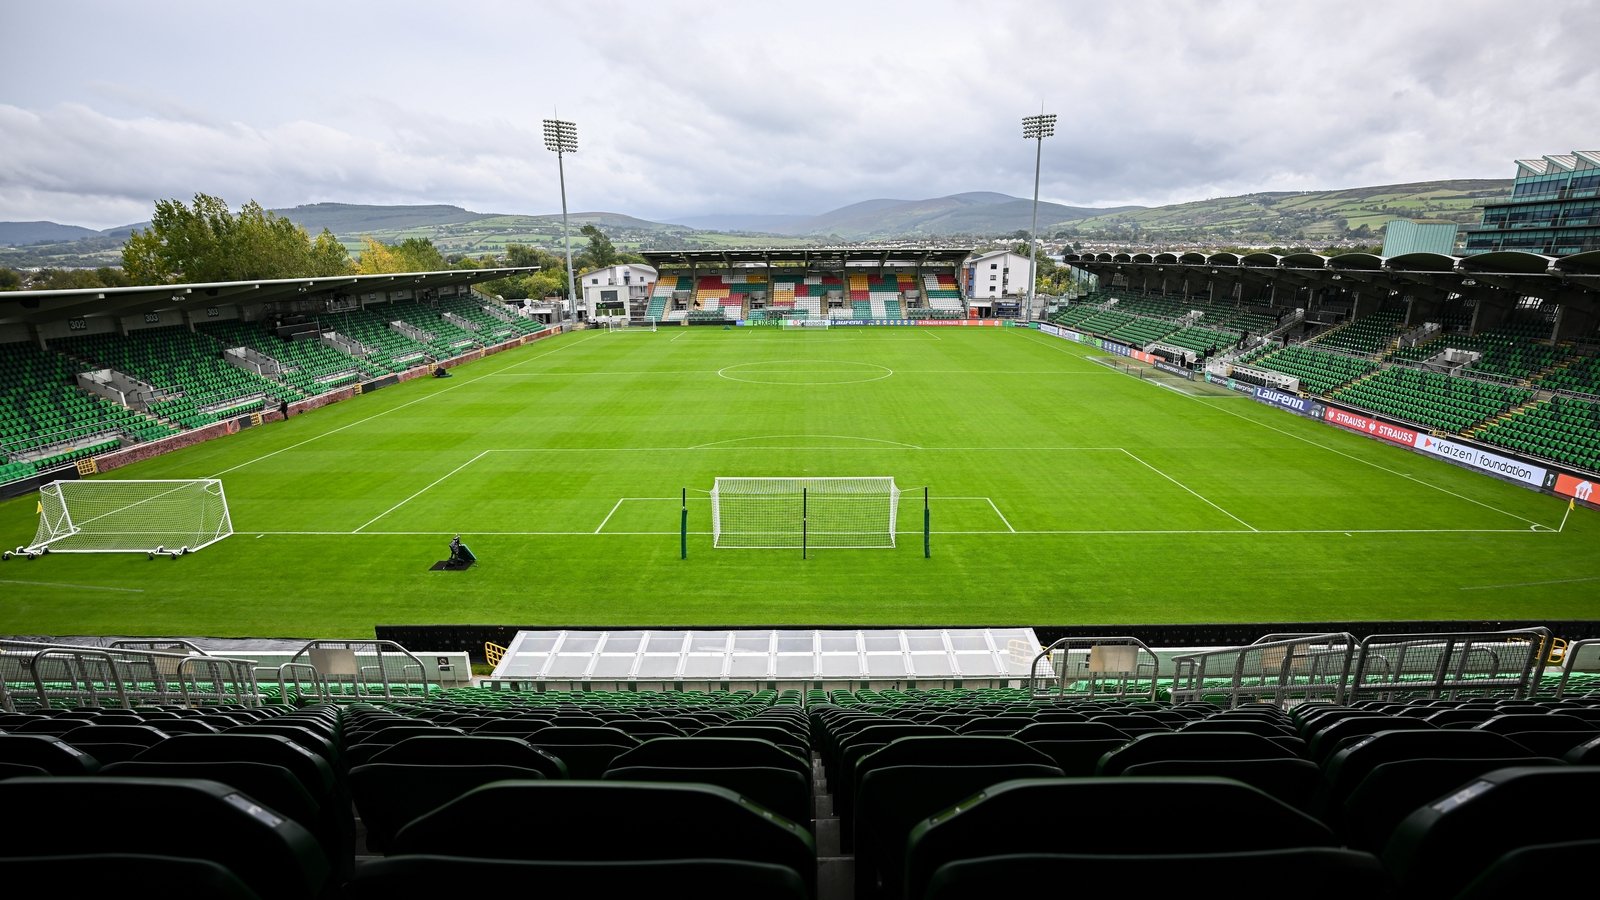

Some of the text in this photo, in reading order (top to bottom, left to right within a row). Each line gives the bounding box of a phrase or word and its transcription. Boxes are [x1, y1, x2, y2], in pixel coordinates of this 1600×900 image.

[70, 320, 86, 329] 302
[145, 314, 159, 322] 303
[1336, 412, 1413, 443] STRAUSS STRAUSS
[1437, 441, 1532, 480] kaizen foundation
